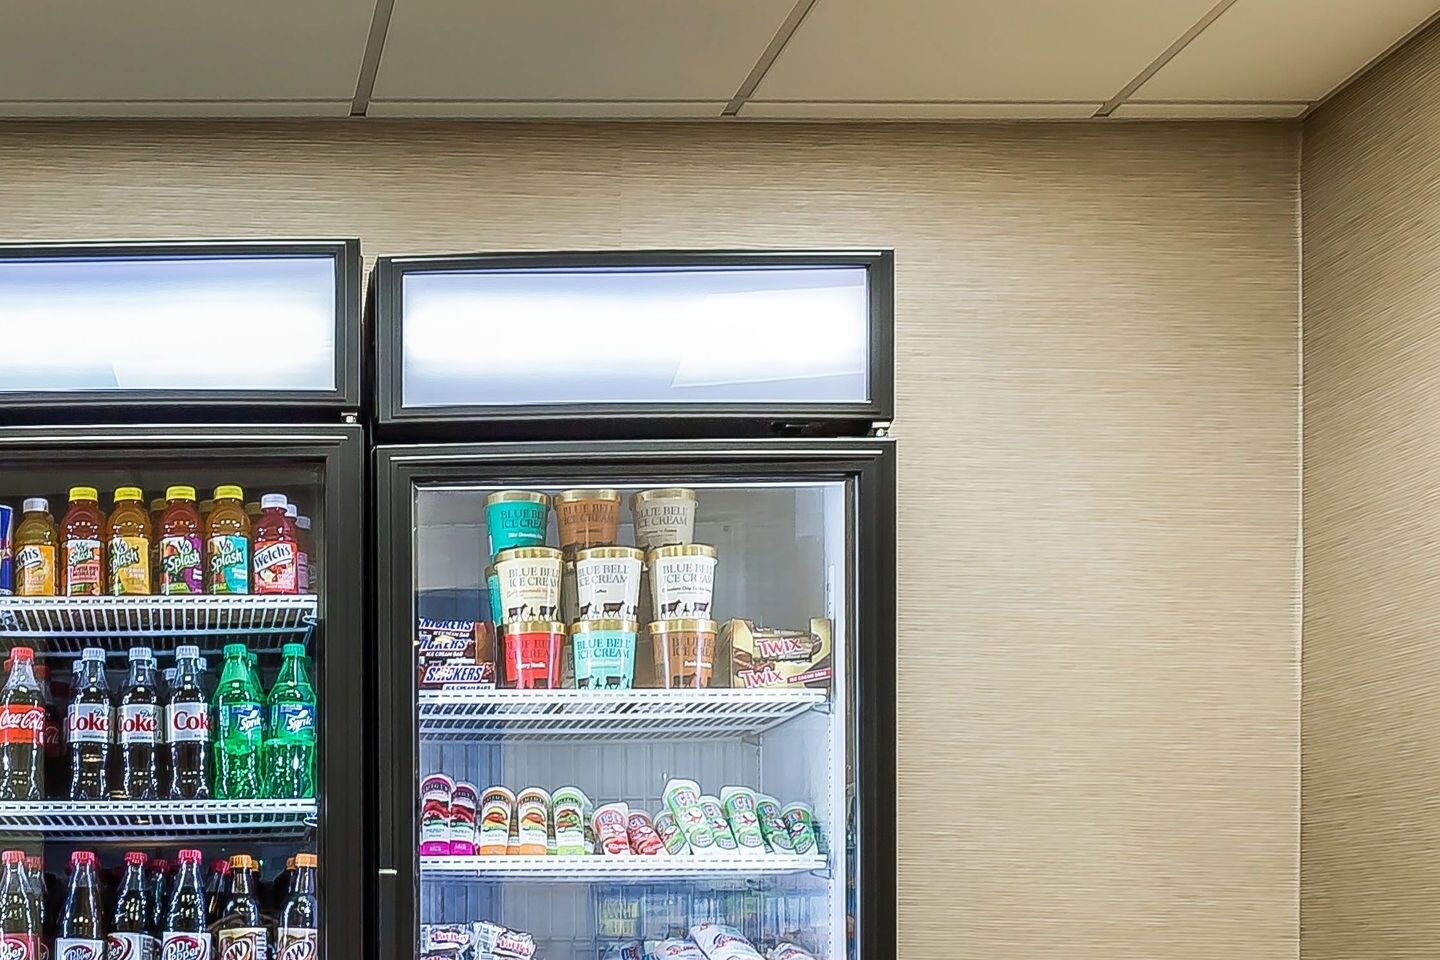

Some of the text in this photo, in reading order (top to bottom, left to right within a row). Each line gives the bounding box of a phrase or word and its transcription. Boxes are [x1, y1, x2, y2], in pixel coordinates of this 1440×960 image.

[501, 509, 530, 520] BLUE
[563, 505, 590, 515] BLUE
[637, 506, 688, 517] BLUE BELL
[501, 519, 543, 529] ICE CREA
[655, 515, 688, 526] CREAM
[177, 540, 191, 554] V8
[218, 539, 233, 553] V8
[167, 550, 201, 572] Splash
[211, 549, 244, 573] Splash
[254, 543, 291, 568] Welch's
[508, 567, 538, 578] BLUE
[578, 564, 630, 576] BLUE BELL
[663, 563, 693, 574] BLUE
[509, 578, 526, 587] ICE
[592, 575, 628, 585] CREAM
[419, 618, 474, 630] NICKERS
[577, 637, 631, 649] BLUE BELL
[577, 648, 630, 659] ICE CREAM
[426, 667, 483, 681] SCKERS
[0, 709, 45, 730] Coca-Cola
[68, 712, 109, 732] Coke
[117, 713, 158, 733] Coke
[173, 711, 211, 731] Cok
